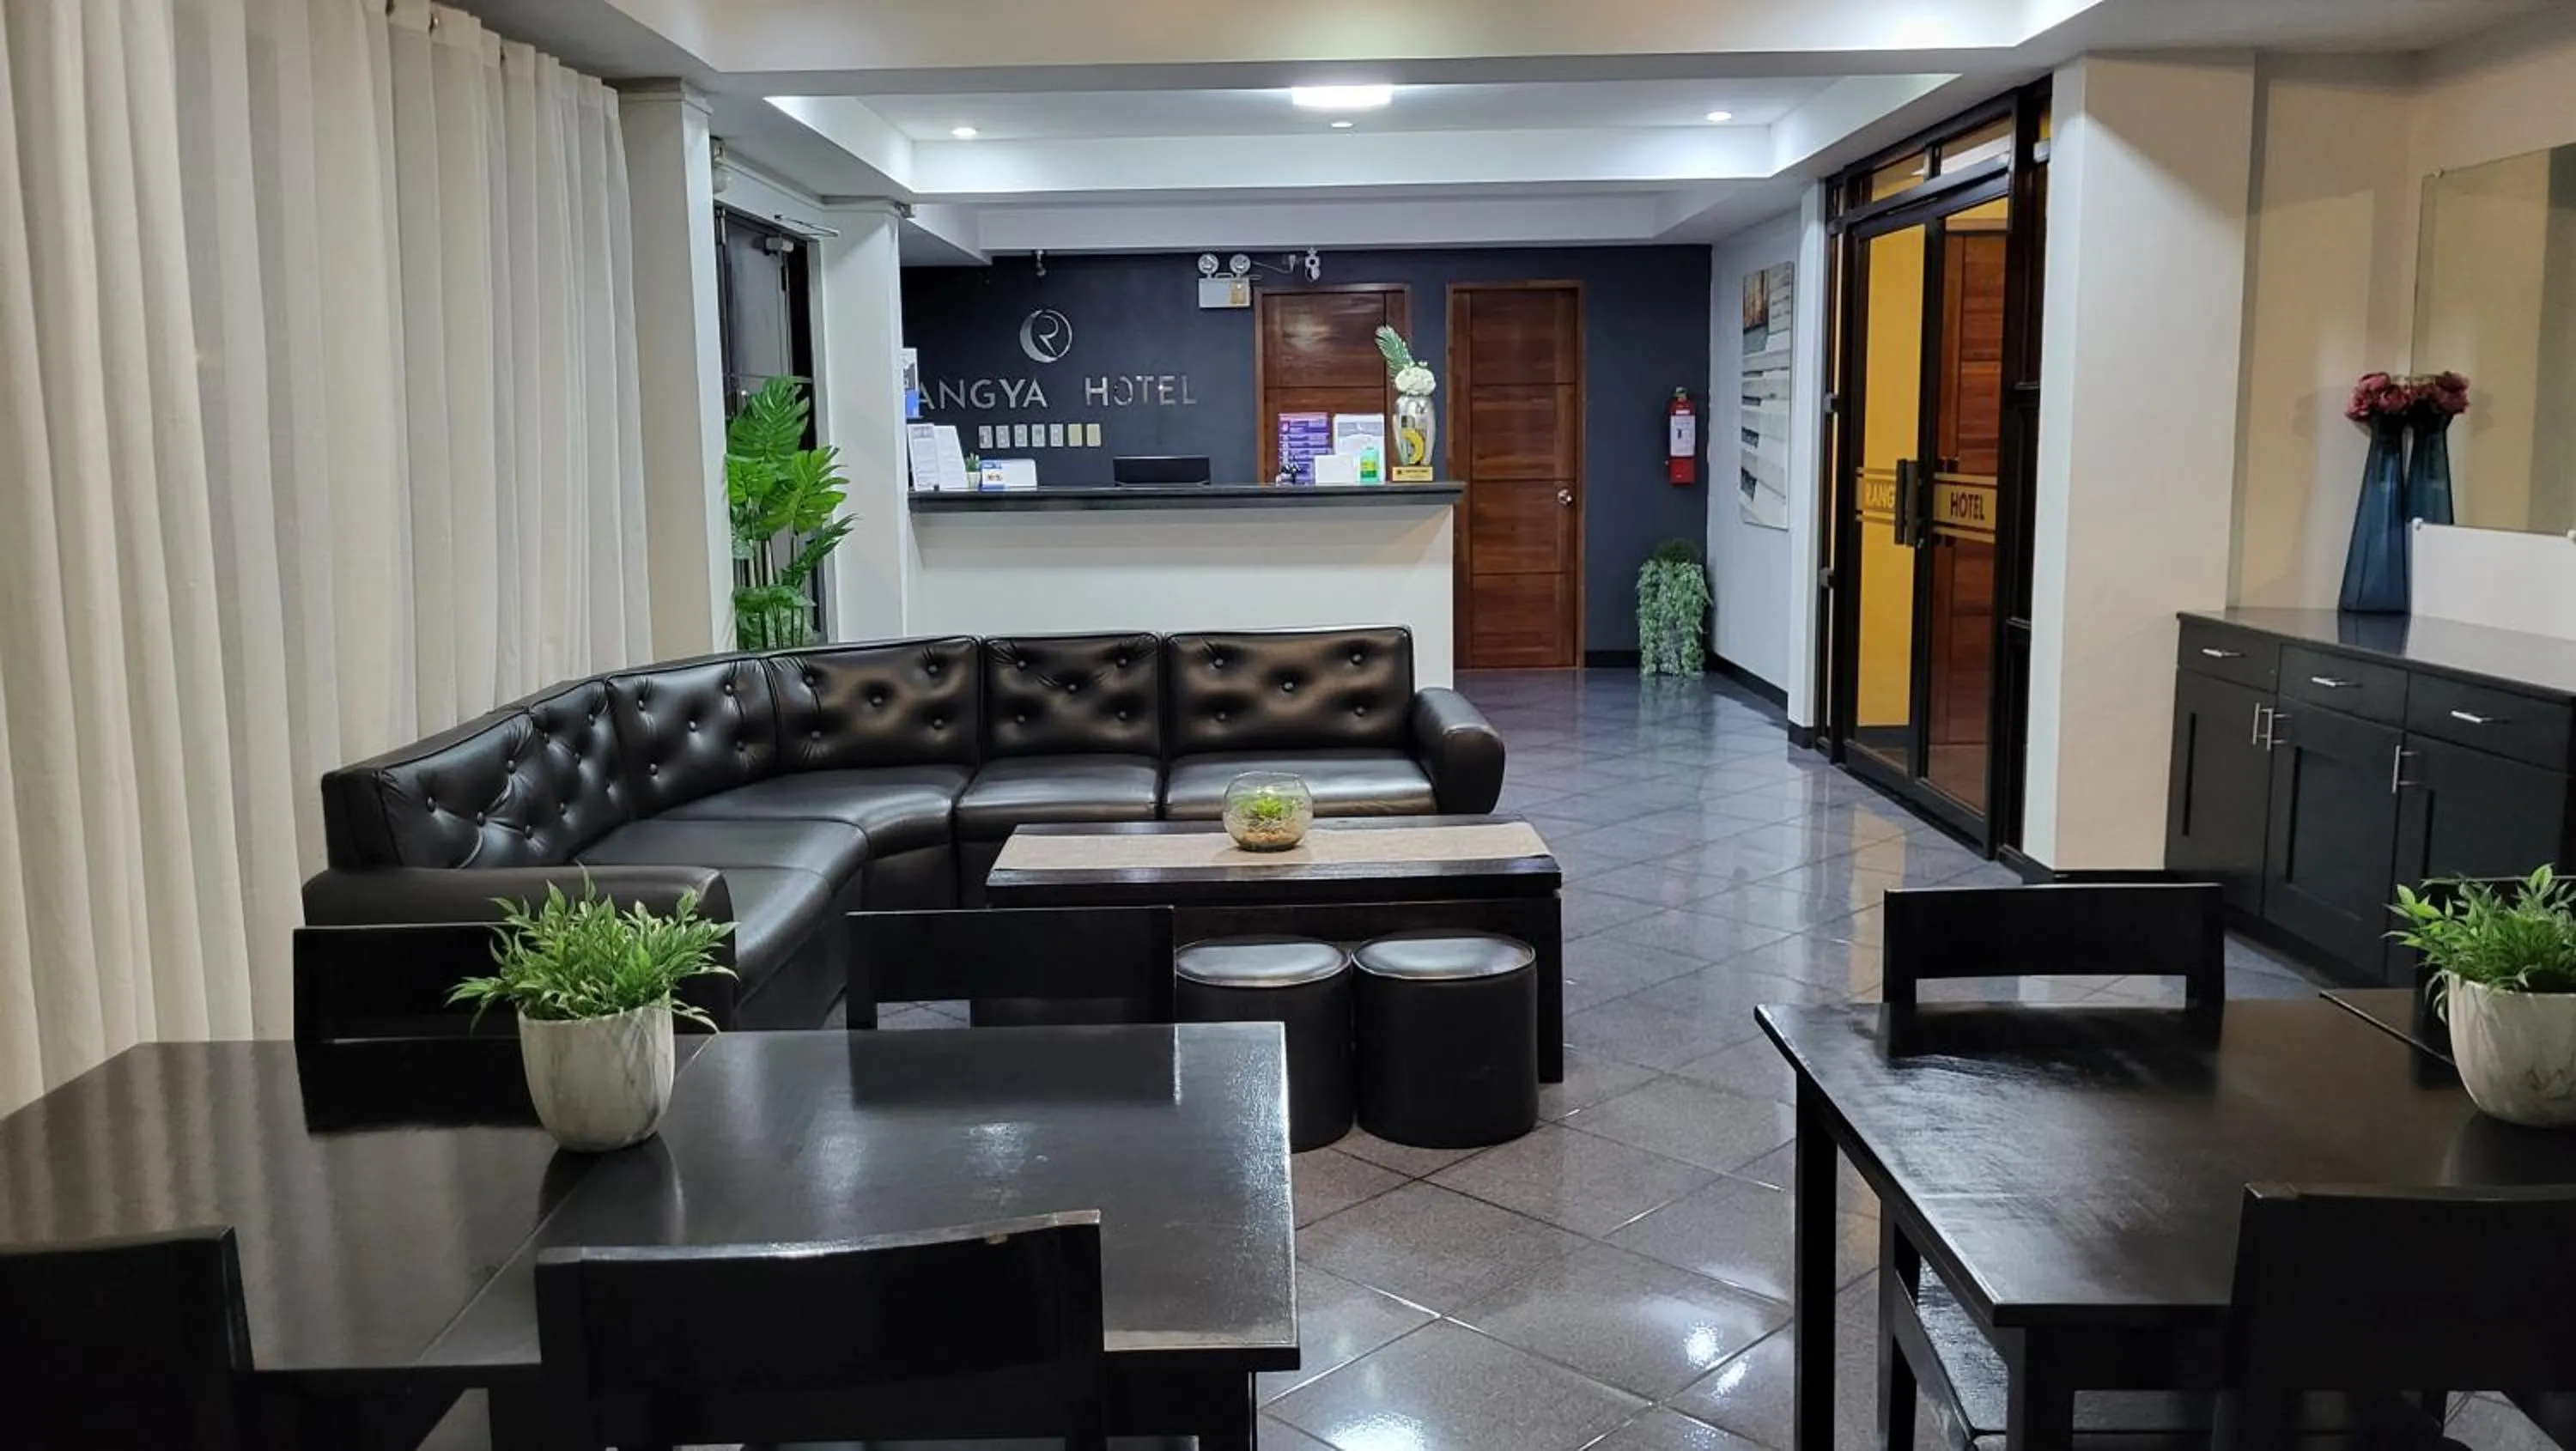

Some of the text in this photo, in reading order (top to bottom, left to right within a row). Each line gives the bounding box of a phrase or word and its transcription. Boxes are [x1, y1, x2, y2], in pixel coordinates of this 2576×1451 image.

[918, 375, 1198, 410] ANGYA HOTEL
[1864, 481, 1985, 521] RANG HOTEL
